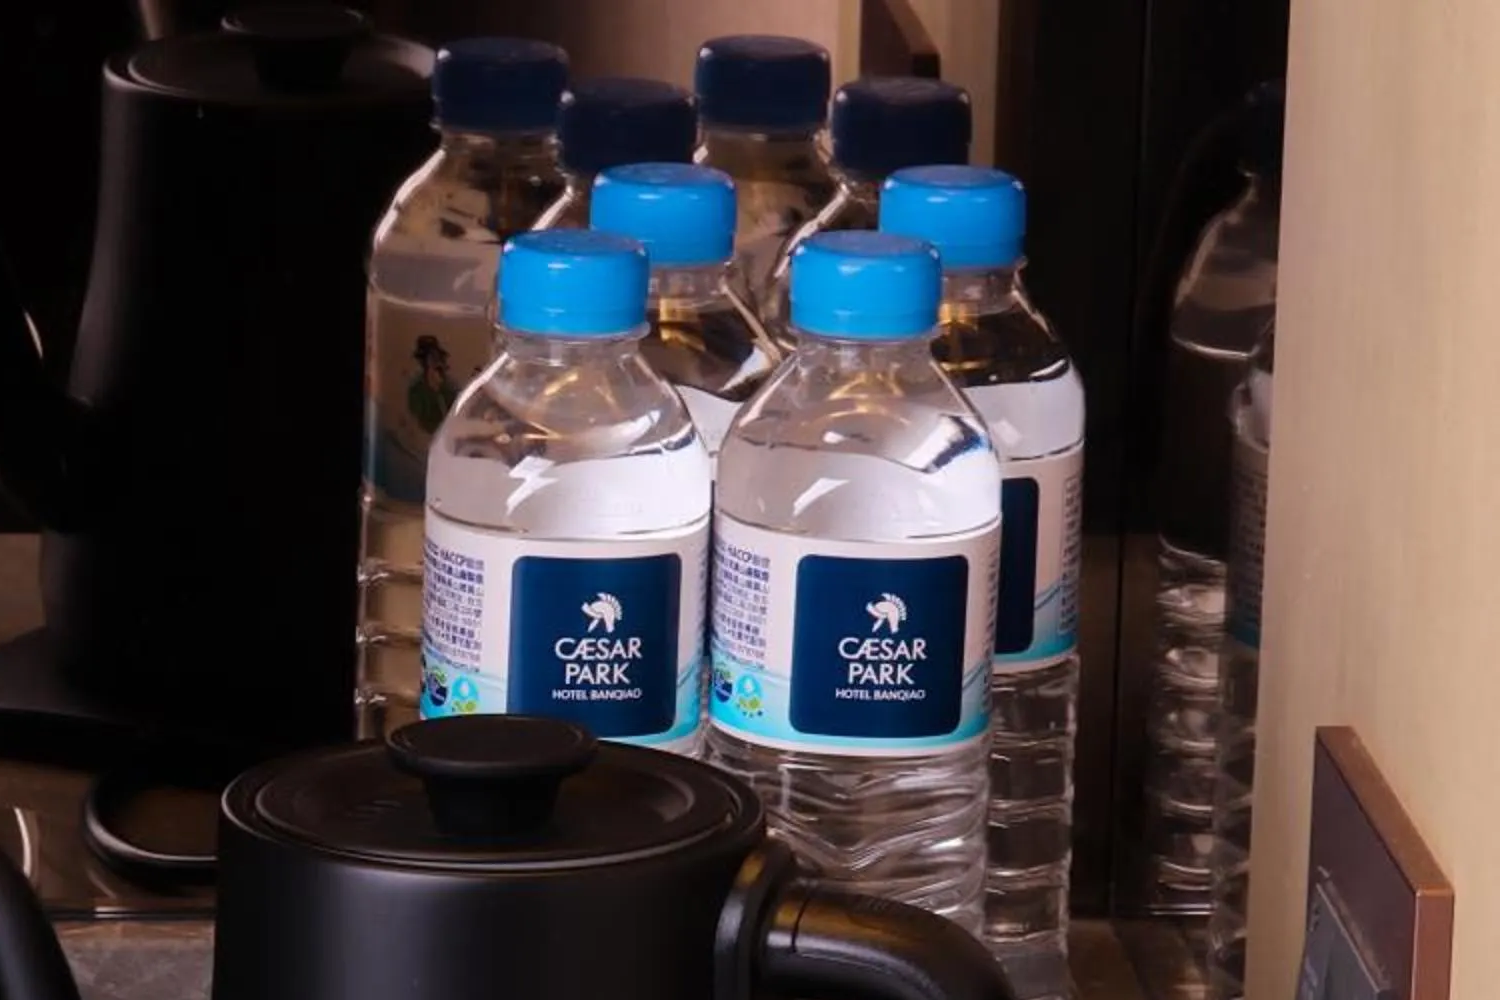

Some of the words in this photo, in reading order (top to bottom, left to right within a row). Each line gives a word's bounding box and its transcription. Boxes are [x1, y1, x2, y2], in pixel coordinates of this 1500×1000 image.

[564, 662, 632, 685] PARK
[847, 662, 916, 685] PARK
[551, 689, 588, 701] HOTEL
[590, 687, 643, 701] BANQIAO
[835, 688, 872, 701] HOTEL
[873, 688, 927, 701] BANQIAO
